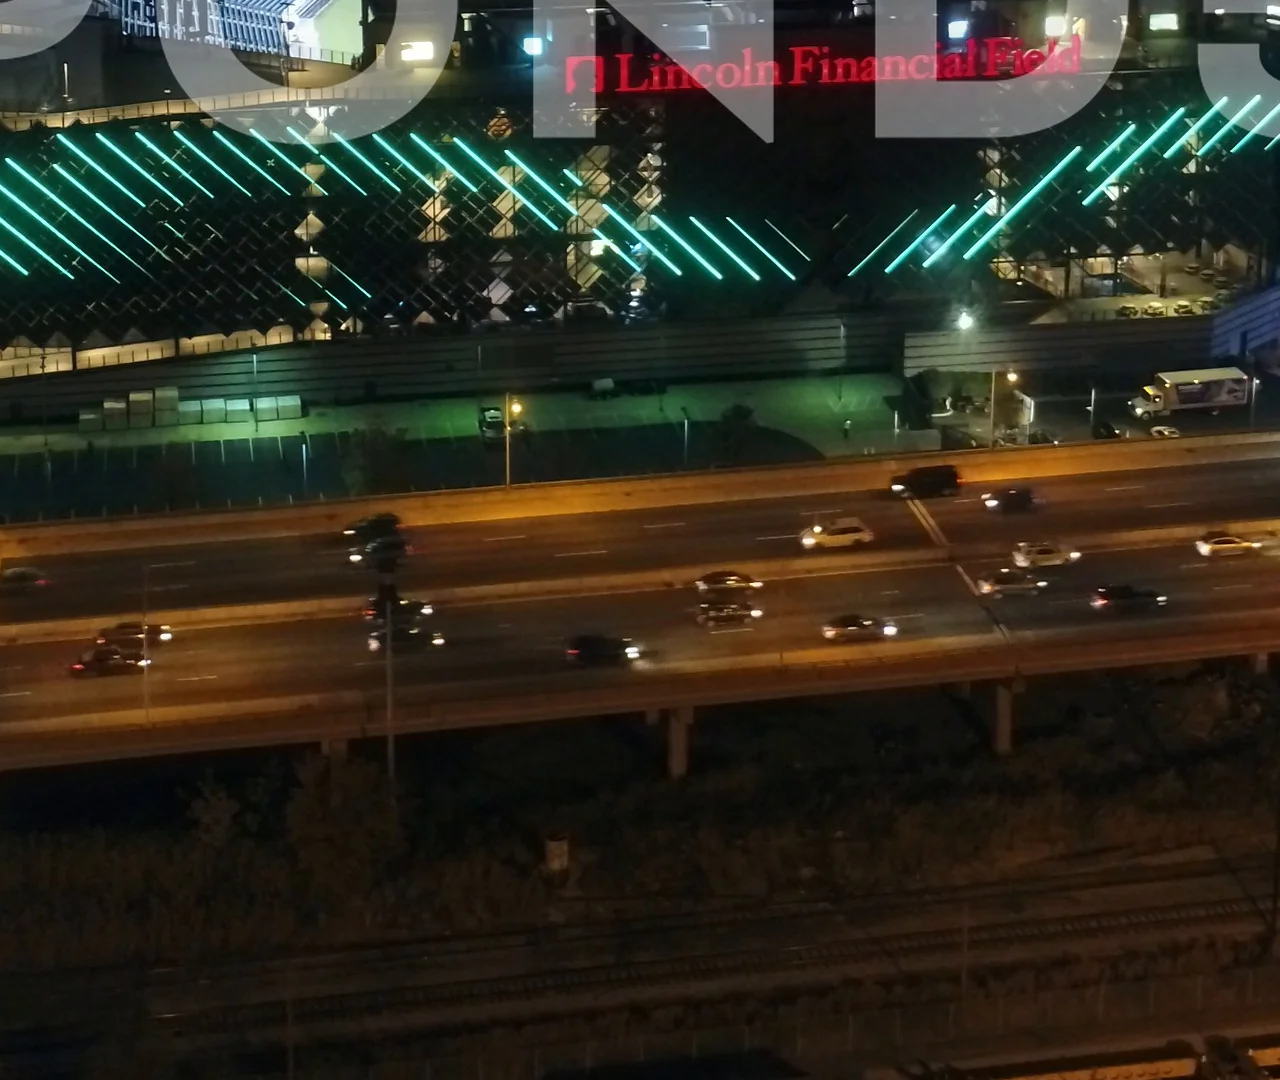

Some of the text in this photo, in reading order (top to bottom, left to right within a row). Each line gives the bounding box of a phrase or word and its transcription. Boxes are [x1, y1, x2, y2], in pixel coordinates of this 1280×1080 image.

[615, 34, 1082, 92] Lincoln Financial Field
